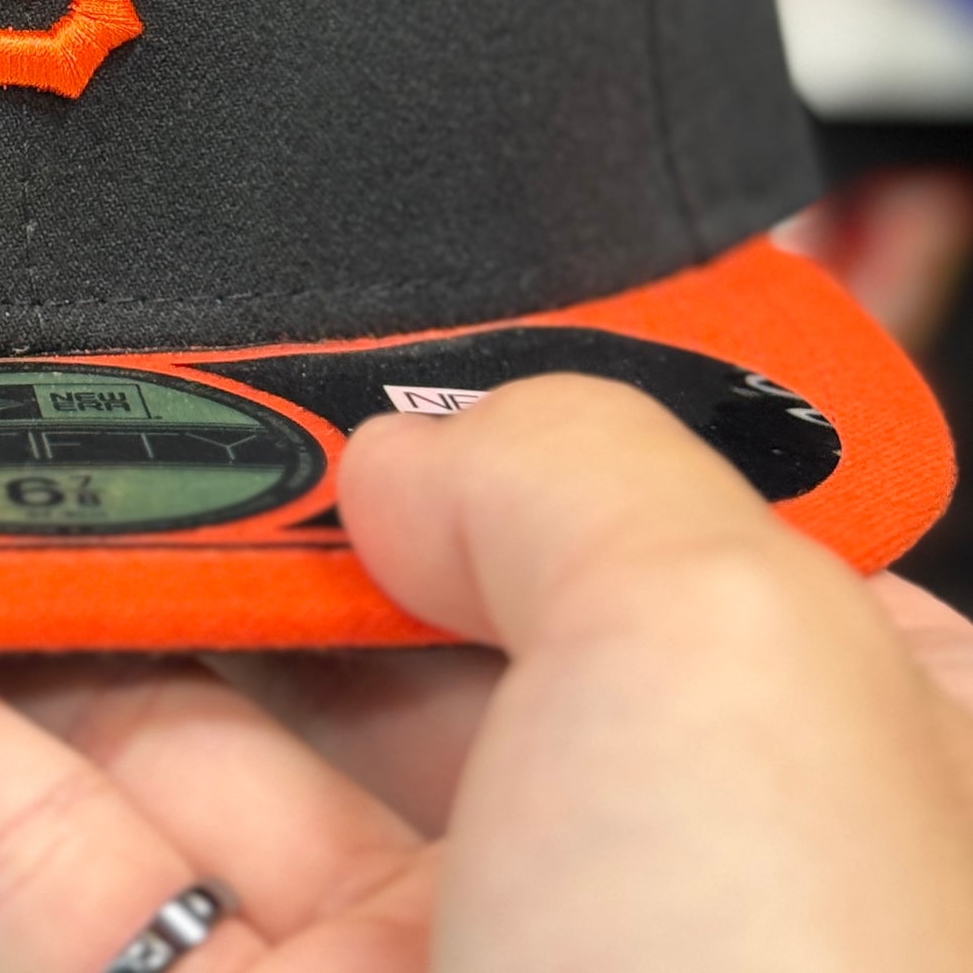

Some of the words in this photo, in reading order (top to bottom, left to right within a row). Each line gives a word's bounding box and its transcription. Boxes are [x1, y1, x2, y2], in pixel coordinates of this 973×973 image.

[49, 391, 127, 403] NEW
[402, 390, 479, 411] NE
[51, 400, 132, 412] ERA
